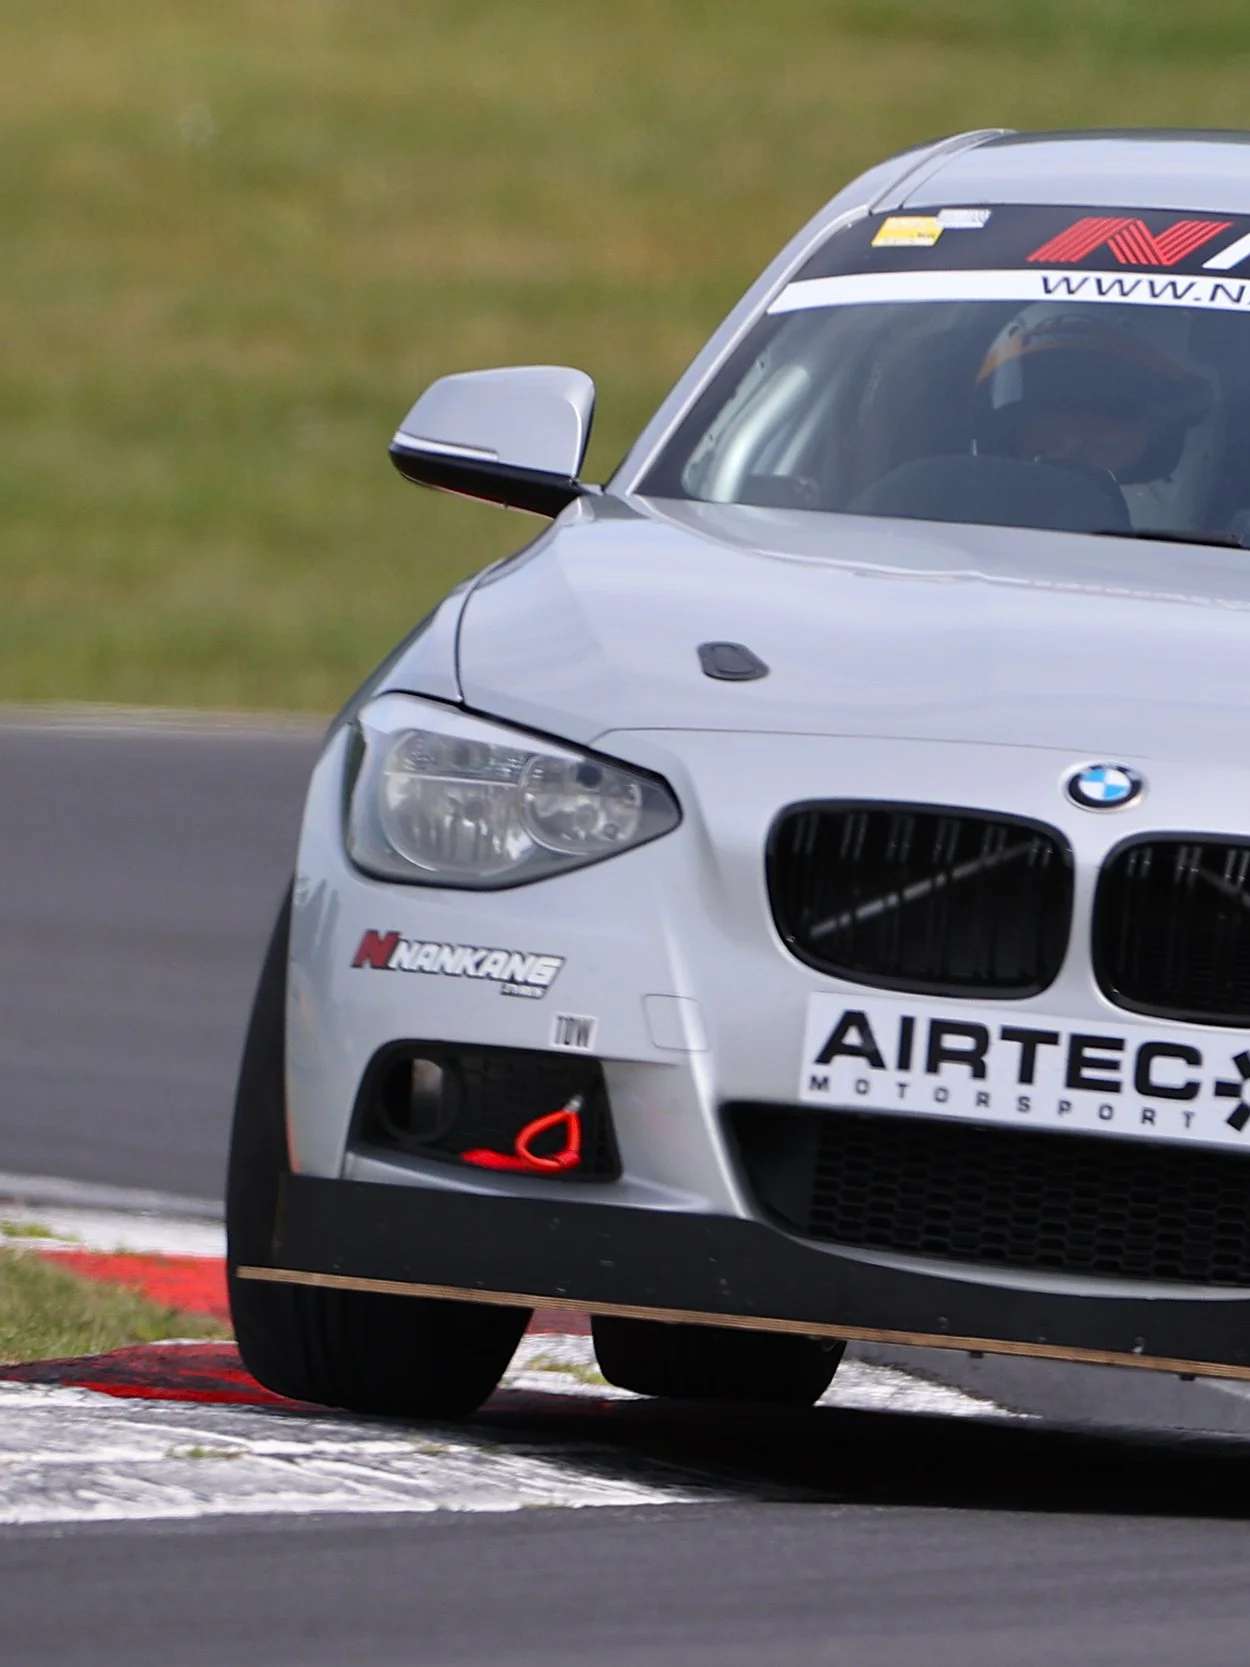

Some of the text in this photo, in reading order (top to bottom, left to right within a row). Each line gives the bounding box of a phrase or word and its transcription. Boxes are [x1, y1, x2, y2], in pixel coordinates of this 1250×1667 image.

[388, 938, 566, 988] NANKANG
[813, 1009, 1204, 1101] AIRTEC
[809, 1074, 1197, 1130] MOTORSPORT
